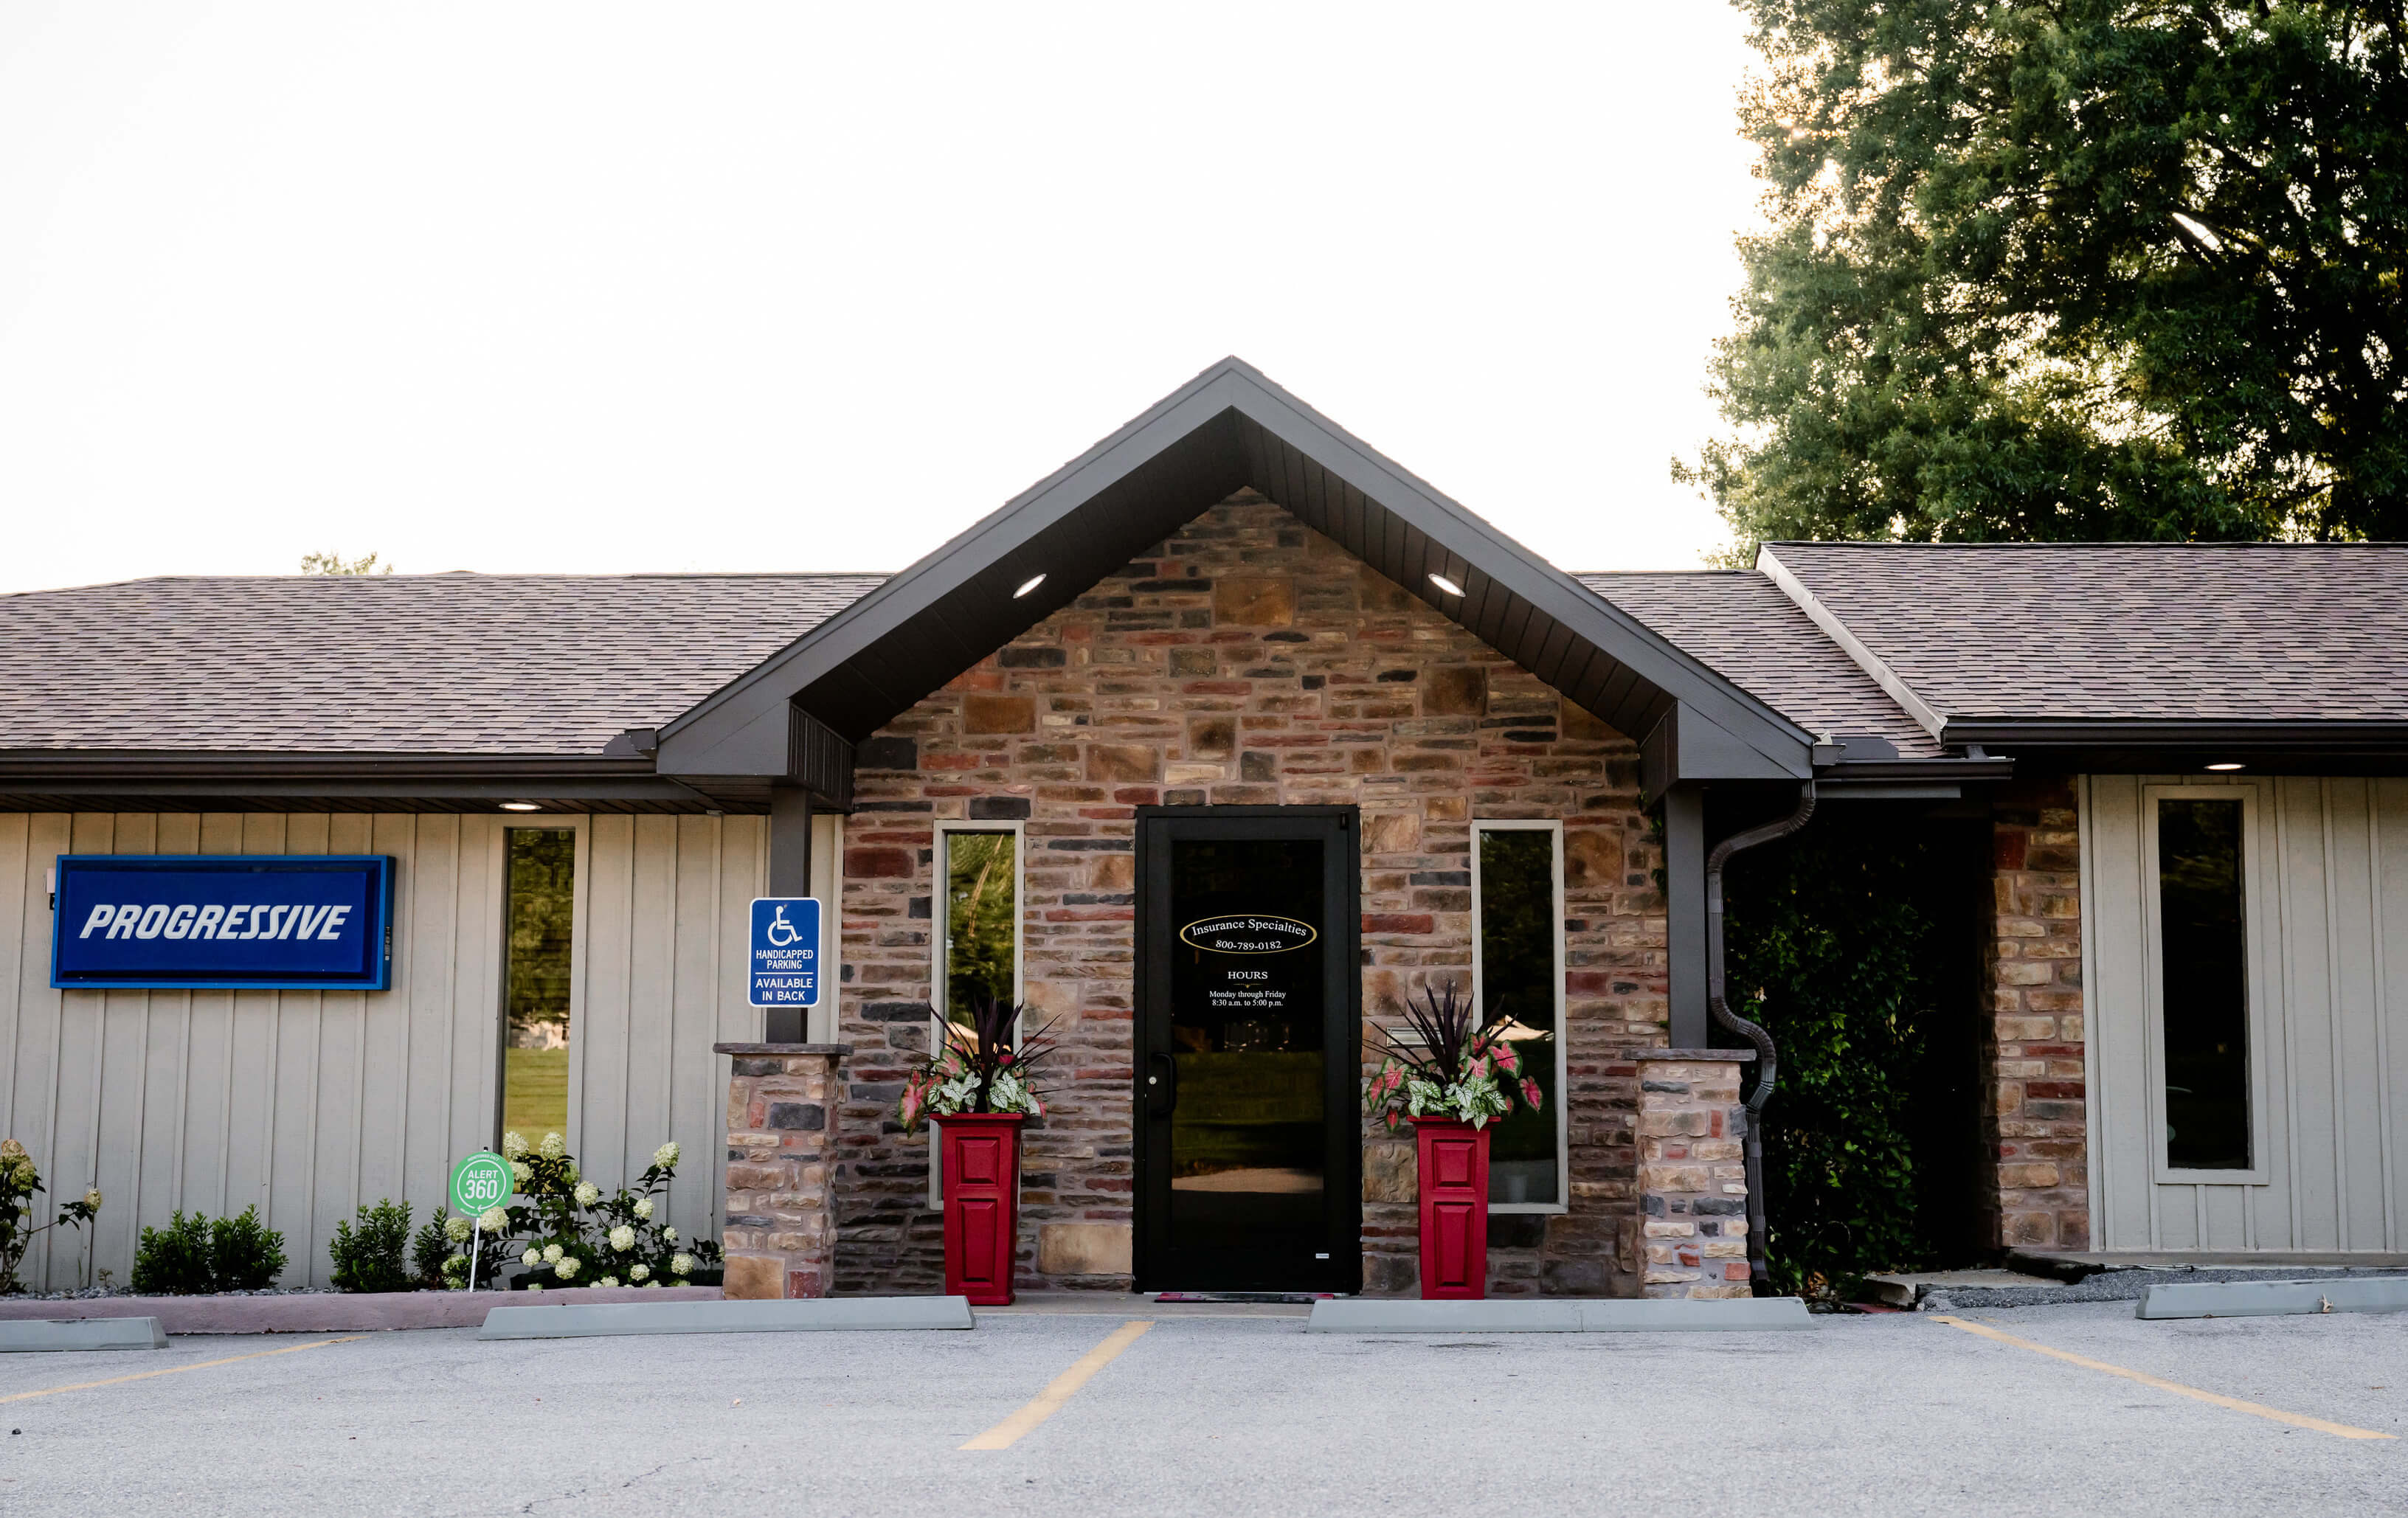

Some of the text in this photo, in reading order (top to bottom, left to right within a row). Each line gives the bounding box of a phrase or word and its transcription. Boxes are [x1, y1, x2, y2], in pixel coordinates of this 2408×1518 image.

[79, 904, 353, 940] PROGRESSIVE
[1191, 918, 1307, 937] Insurance Specialties
[1215, 939, 1282, 951] 800-789-0182
[755, 949, 814, 960] HANDICAPPED
[767, 960, 803, 969] PARKING
[1228, 971, 1269, 980] HOURS
[755, 978, 814, 988] AVAILABLE
[762, 991, 806, 1001] IN BACK
[1209, 991, 1287, 999] Monday through Friday
[1268, 1000, 1284, 1008] p.m.
[467, 1169, 499, 1179] ALERT
[465, 1179, 498, 1199] 360
